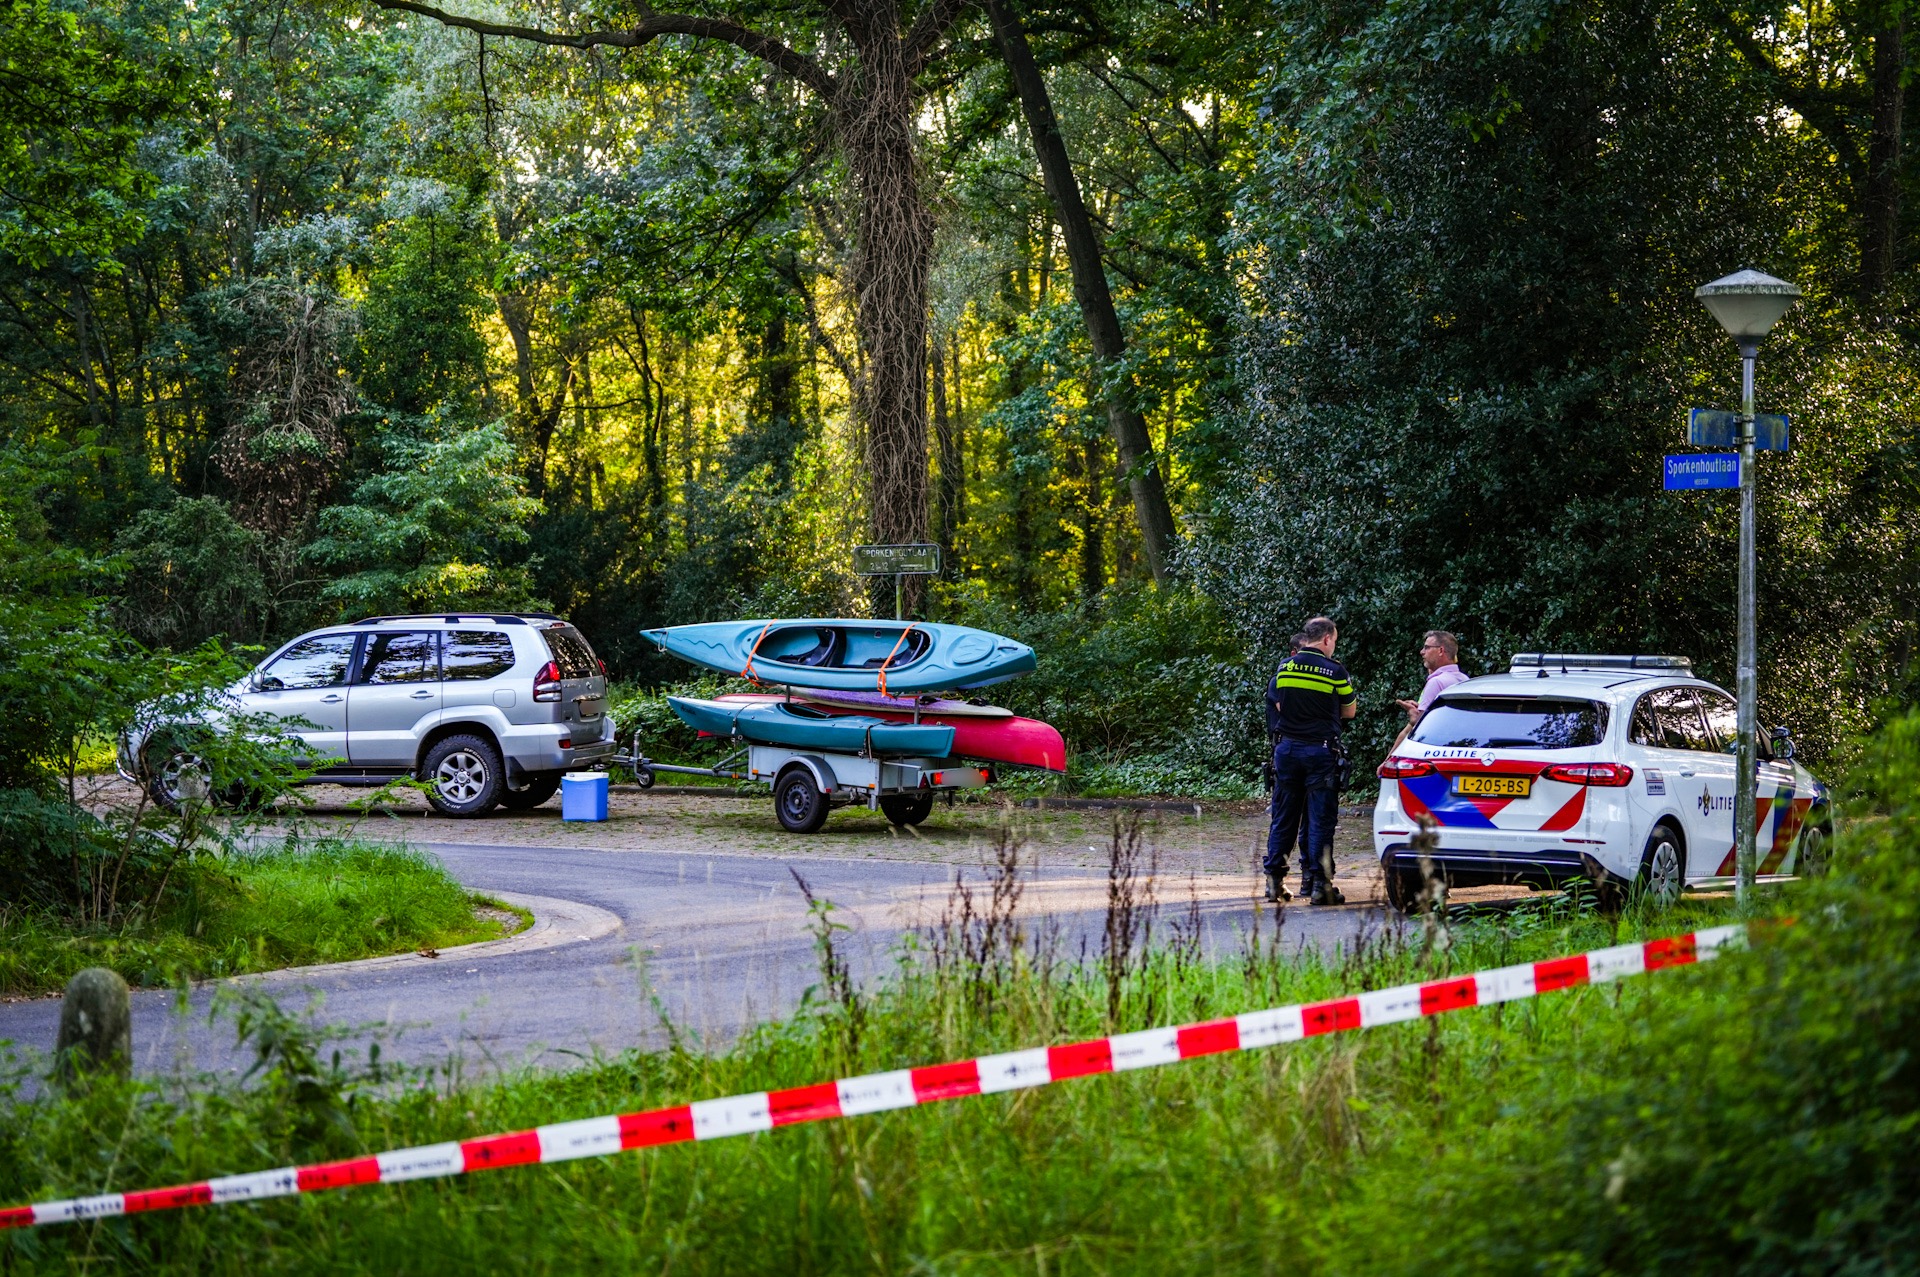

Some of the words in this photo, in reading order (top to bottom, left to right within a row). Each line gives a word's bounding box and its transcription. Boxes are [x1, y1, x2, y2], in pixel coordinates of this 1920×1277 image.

[1667, 458, 1737, 478] Sporkenhoutlaan
[1281, 660, 1320, 673] POLITIE
[1424, 749, 1478, 758] POLITIE
[1463, 778, 1524, 793] L-205-BS
[1697, 794, 1733, 816] POLITIE
